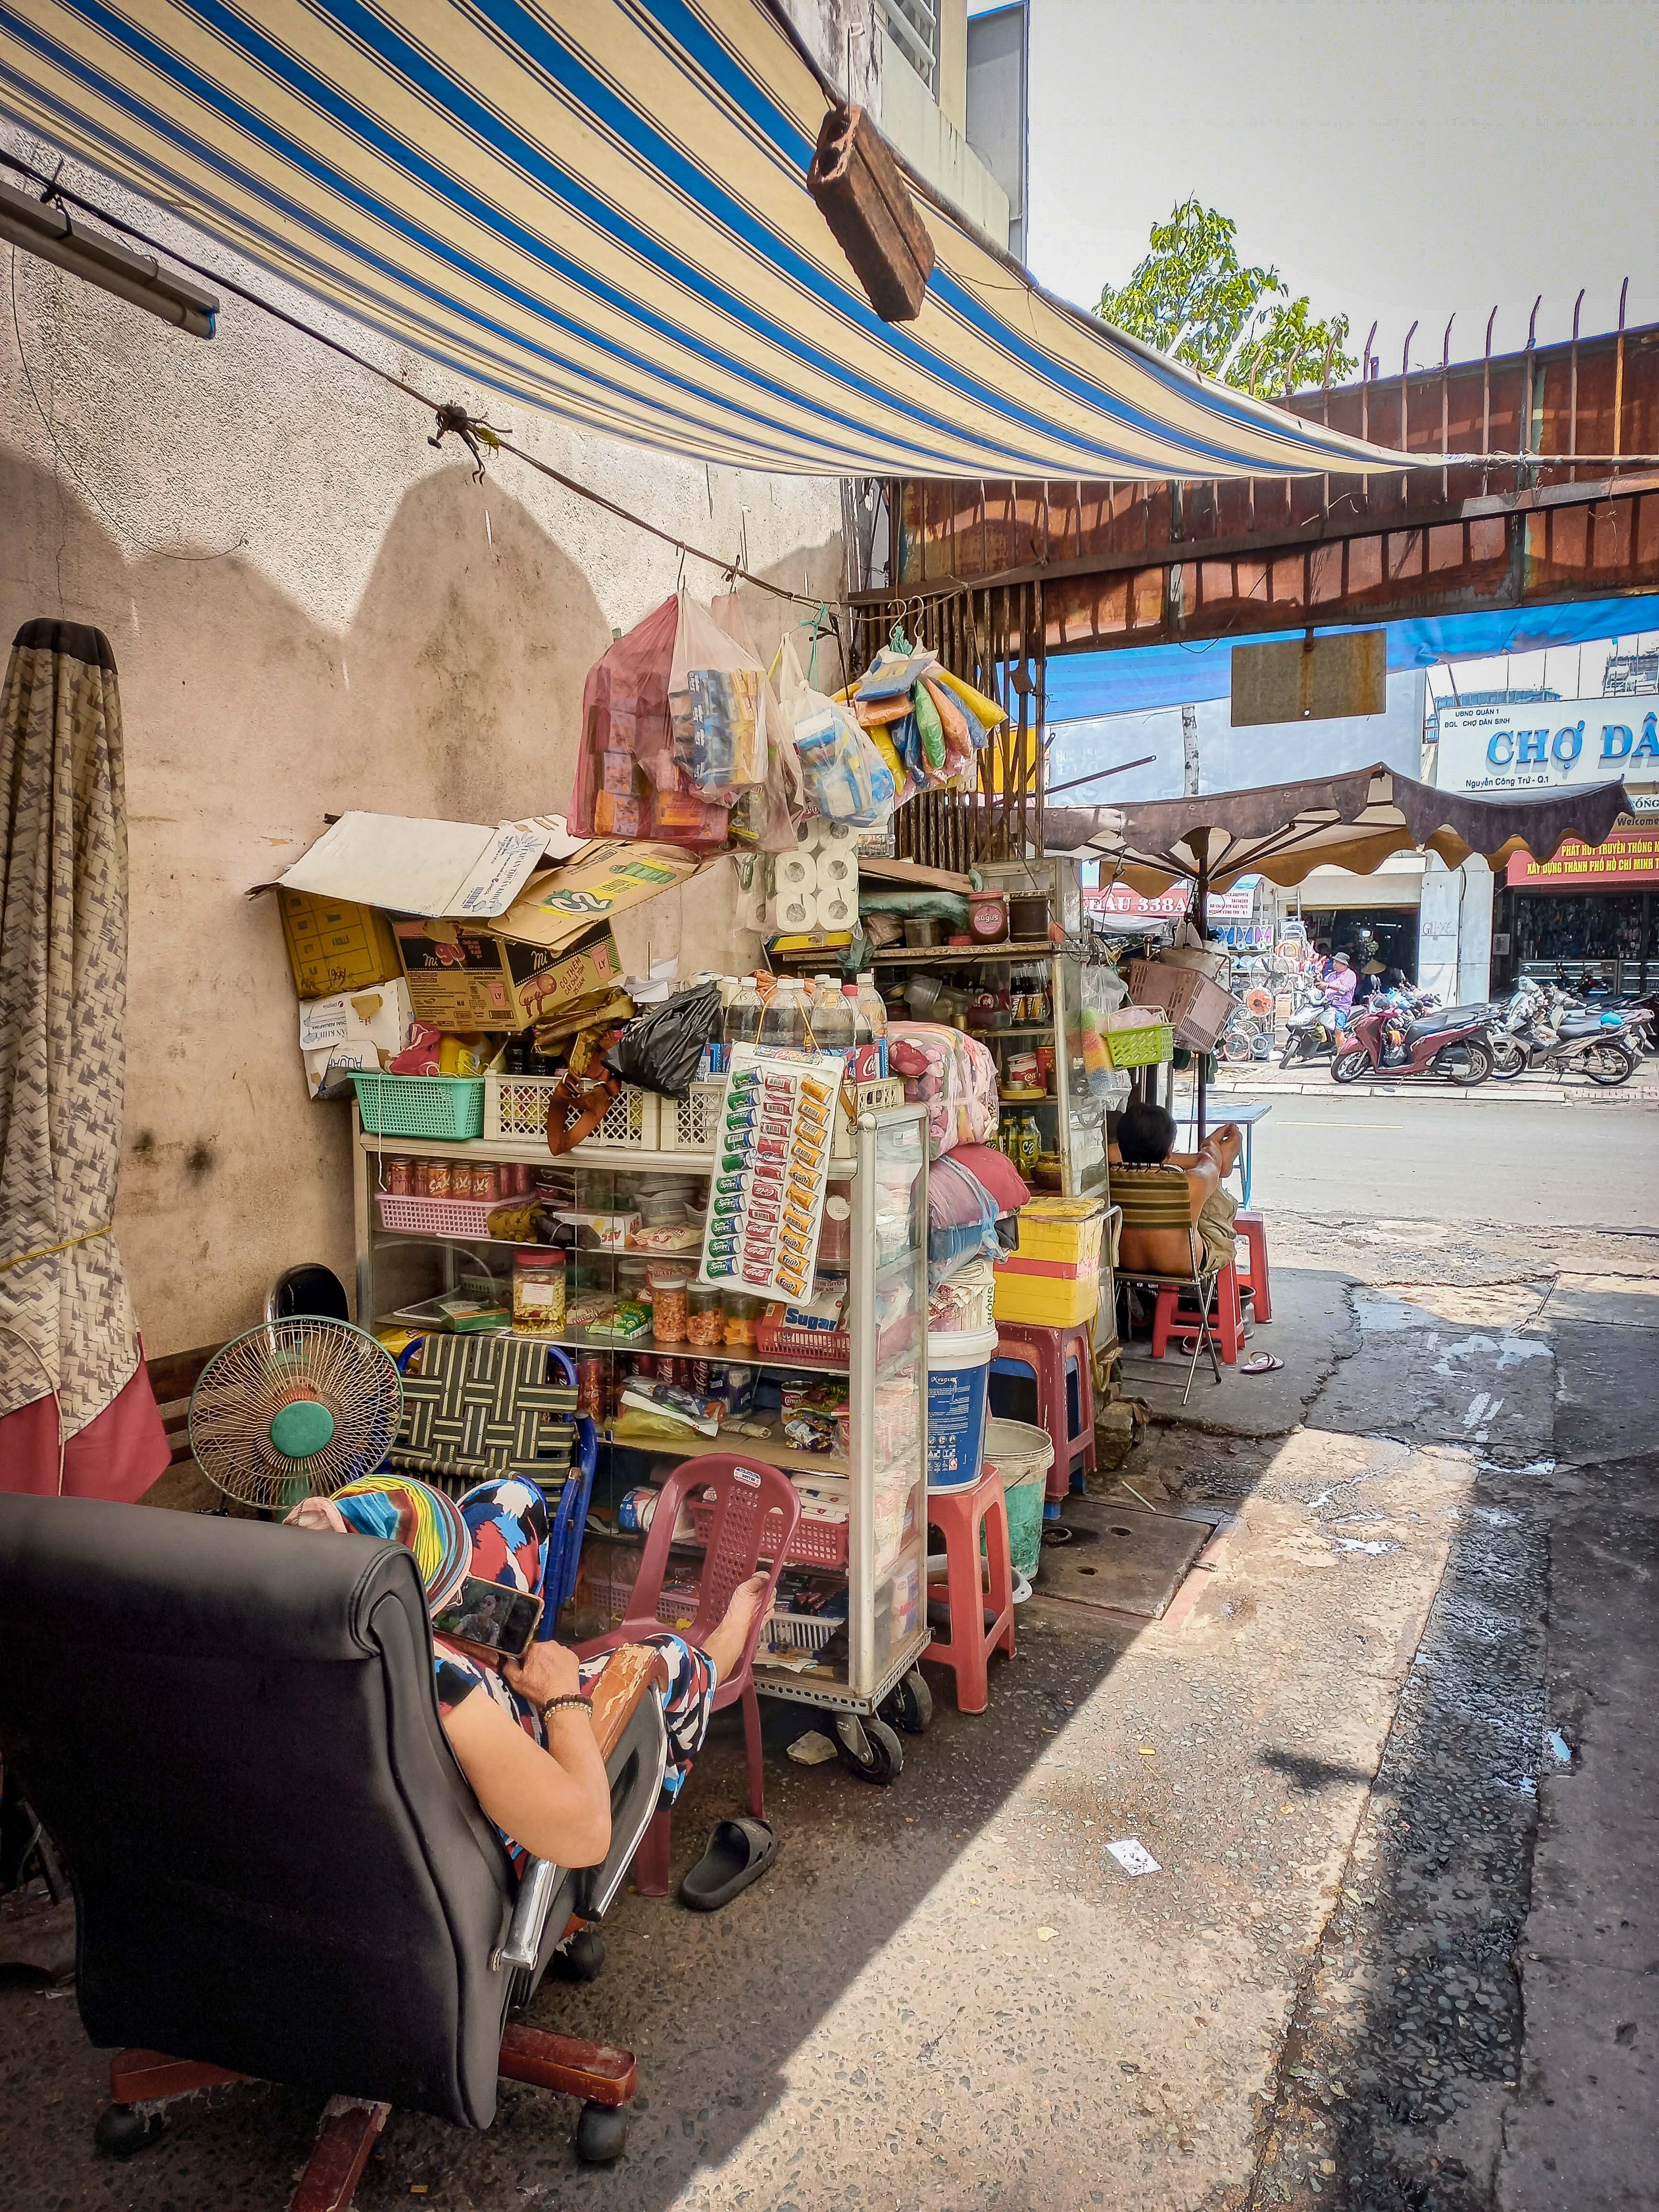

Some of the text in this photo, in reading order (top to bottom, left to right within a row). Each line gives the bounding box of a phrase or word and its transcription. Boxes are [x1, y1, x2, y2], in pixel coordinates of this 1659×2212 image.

[1475, 708, 1493, 717] QUẬN
[1462, 719, 1477, 728] CHỢ
[1487, 720, 1585, 770] CHỢ
[1466, 776, 1493, 788] Nguyễn
[1495, 777, 1515, 787] Công
[1517, 776, 1532, 785] Trứ
[1537, 775, 1549, 784] Q.1
[1561, 843, 1581, 857] PHÁT
[1599, 839, 1626, 855] TRUYỀN
[1627, 838, 1653, 854] THỐNG
[1526, 861, 1540, 875] XÂY
[1542, 861, 1562, 876] DỰNG
[1564, 859, 1588, 874] THÀNH
[1589, 856, 1604, 873] PHỐ
[1606, 856, 1616, 871] HỒ
[1618, 857, 1632, 871] CHÍ
[1633, 858, 1654, 870] MINH
[551, 891, 613, 913] C2
[1137, 896, 1187, 913] 338A
[597, 959, 606, 970] LY
[1022, 1141, 1035, 1155] C2
[601, 1230, 622, 1243] AFC
[785, 1307, 837, 1330] Sugar
